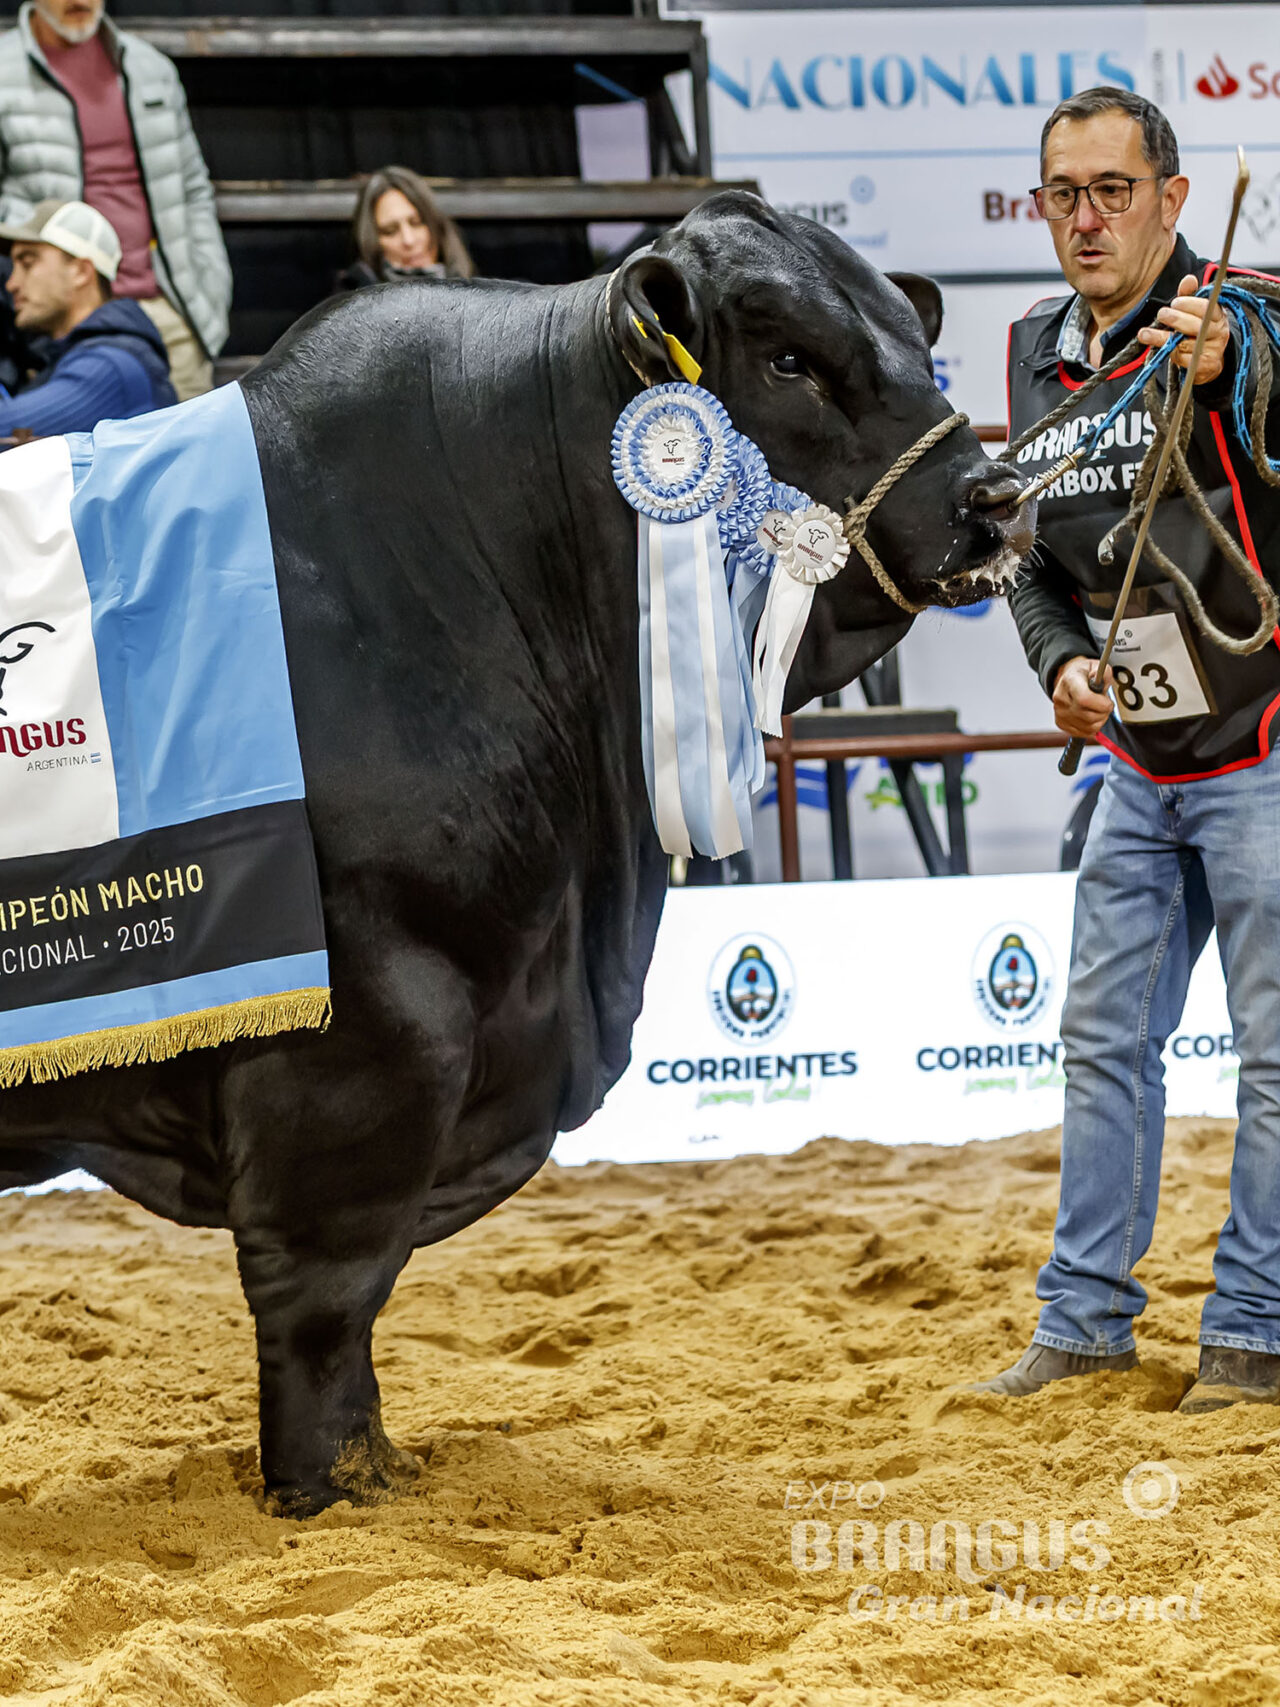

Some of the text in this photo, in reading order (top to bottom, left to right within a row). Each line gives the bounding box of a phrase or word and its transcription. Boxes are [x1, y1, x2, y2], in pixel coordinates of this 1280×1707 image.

[708, 50, 1135, 113] NACIONALES
[1112, 663, 1178, 711] 83
[27, 755, 88, 771] ARGENTINA
[98, 864, 204, 913] MACHO
[118, 916, 176, 952] 2025
[647, 1051, 858, 1084] CORRIENTES
[917, 1042, 1064, 1071] CORRIEN
